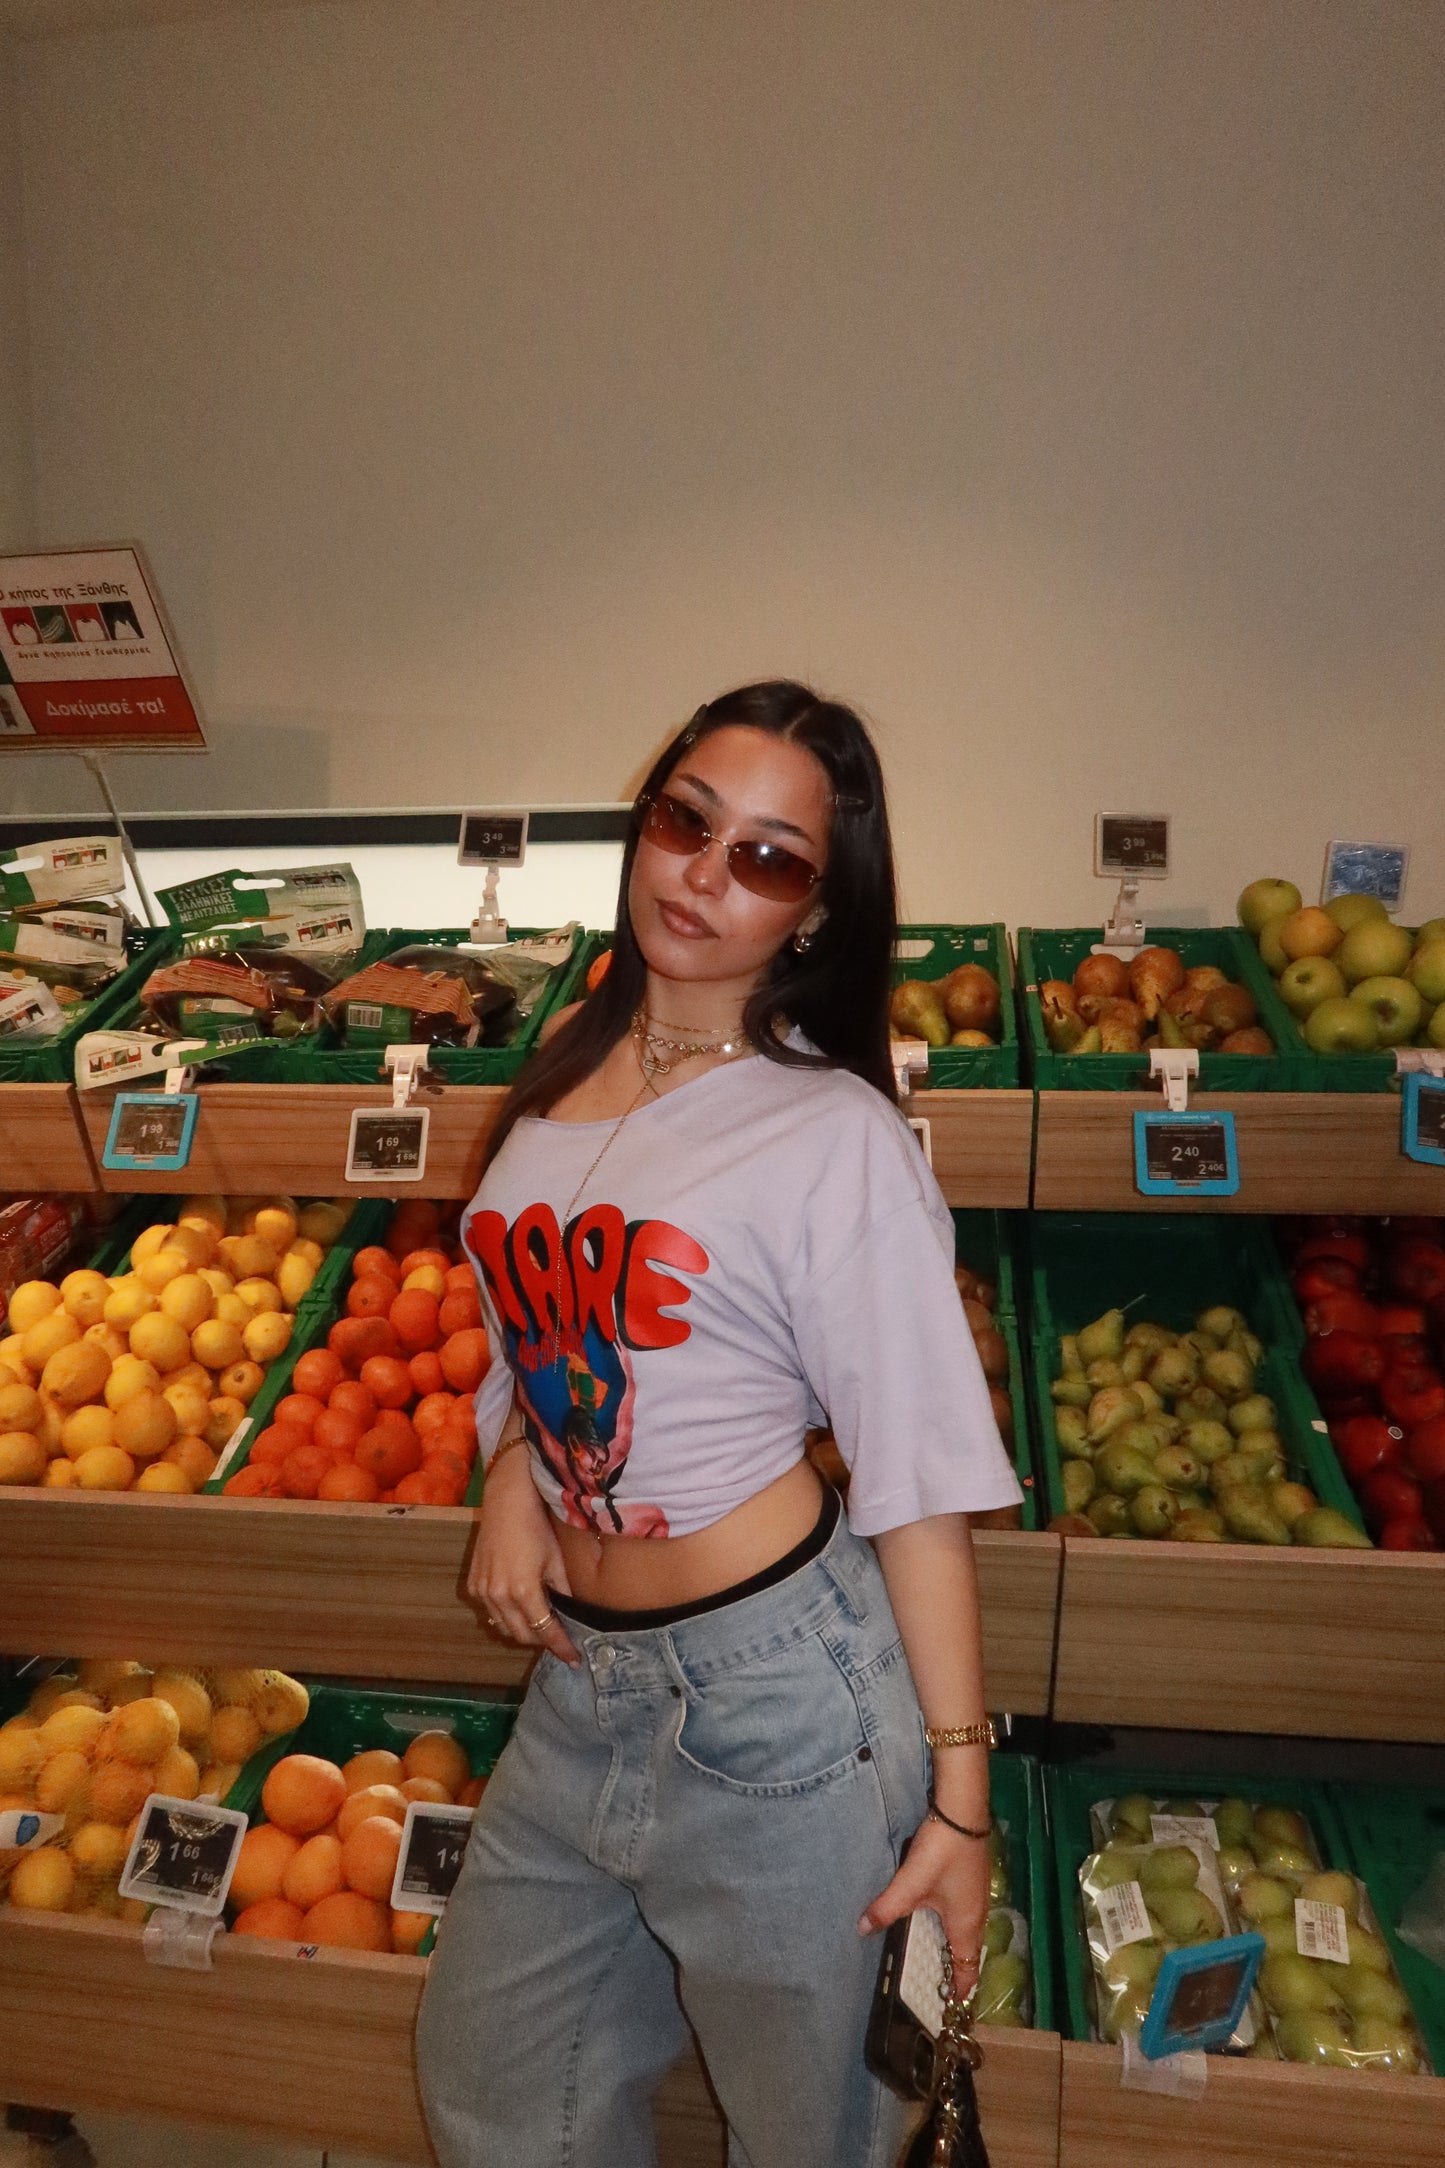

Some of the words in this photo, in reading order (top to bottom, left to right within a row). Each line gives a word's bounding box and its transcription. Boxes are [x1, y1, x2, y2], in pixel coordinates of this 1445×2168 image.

[9, 585, 49, 601] κήπος
[52, 587, 75, 600] της
[77, 582, 129, 597] Ξάνθης
[46, 698, 133, 718] Δοκίμασέ
[136, 696, 165, 714] τα!
